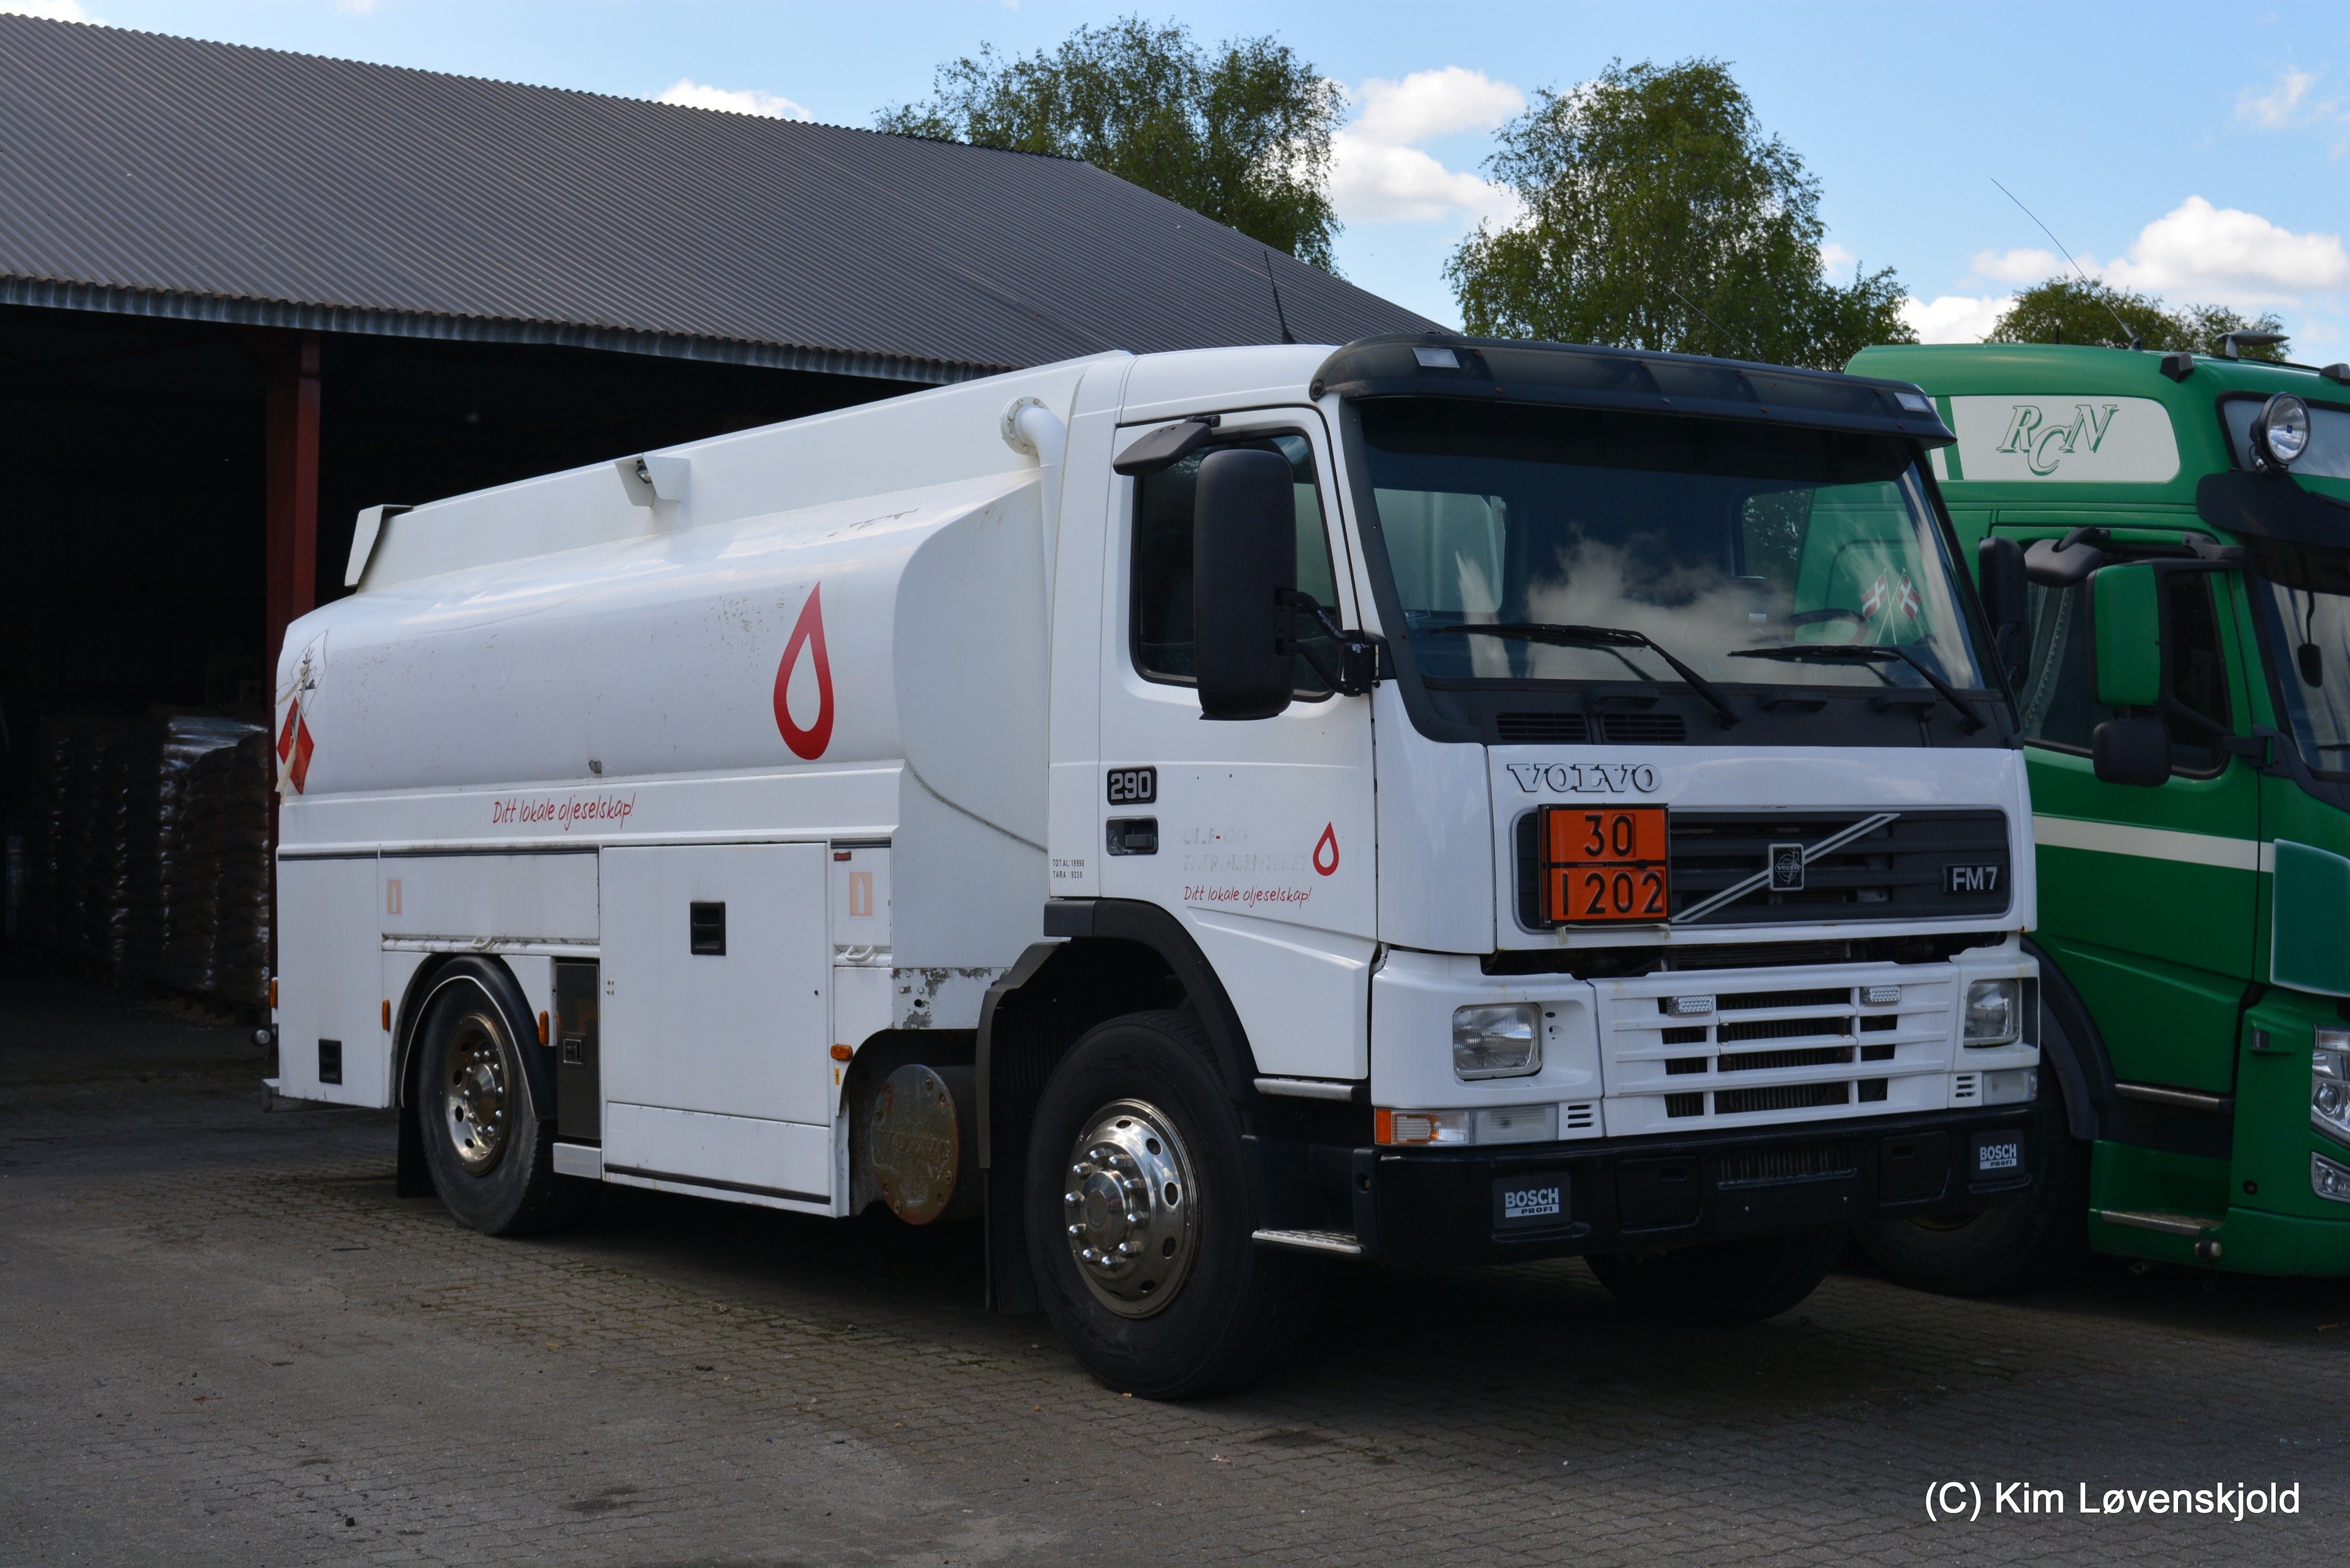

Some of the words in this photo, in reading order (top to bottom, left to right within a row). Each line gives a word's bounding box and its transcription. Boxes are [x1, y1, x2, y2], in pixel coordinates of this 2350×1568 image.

[1996, 405, 2120, 476] RCN
[1111, 771, 1151, 800] 290
[1507, 763, 1662, 793] VOLVO
[493, 798, 517, 824] Ditt
[519, 798, 555, 823] lokale
[558, 793, 636, 832] oljeselskap!
[1583, 813, 1632, 856] 30
[1053, 870, 1067, 879] TARA
[1952, 866, 1997, 891] FM7
[1184, 885, 1204, 900] Ditt
[1208, 886, 1239, 901] lokale
[1243, 885, 1312, 908] oljeselskap!
[1562, 872, 1662, 916] 1202
[1979, 1143, 2017, 1161] BOSCH
[1505, 1187, 1559, 1208] BOSCH
